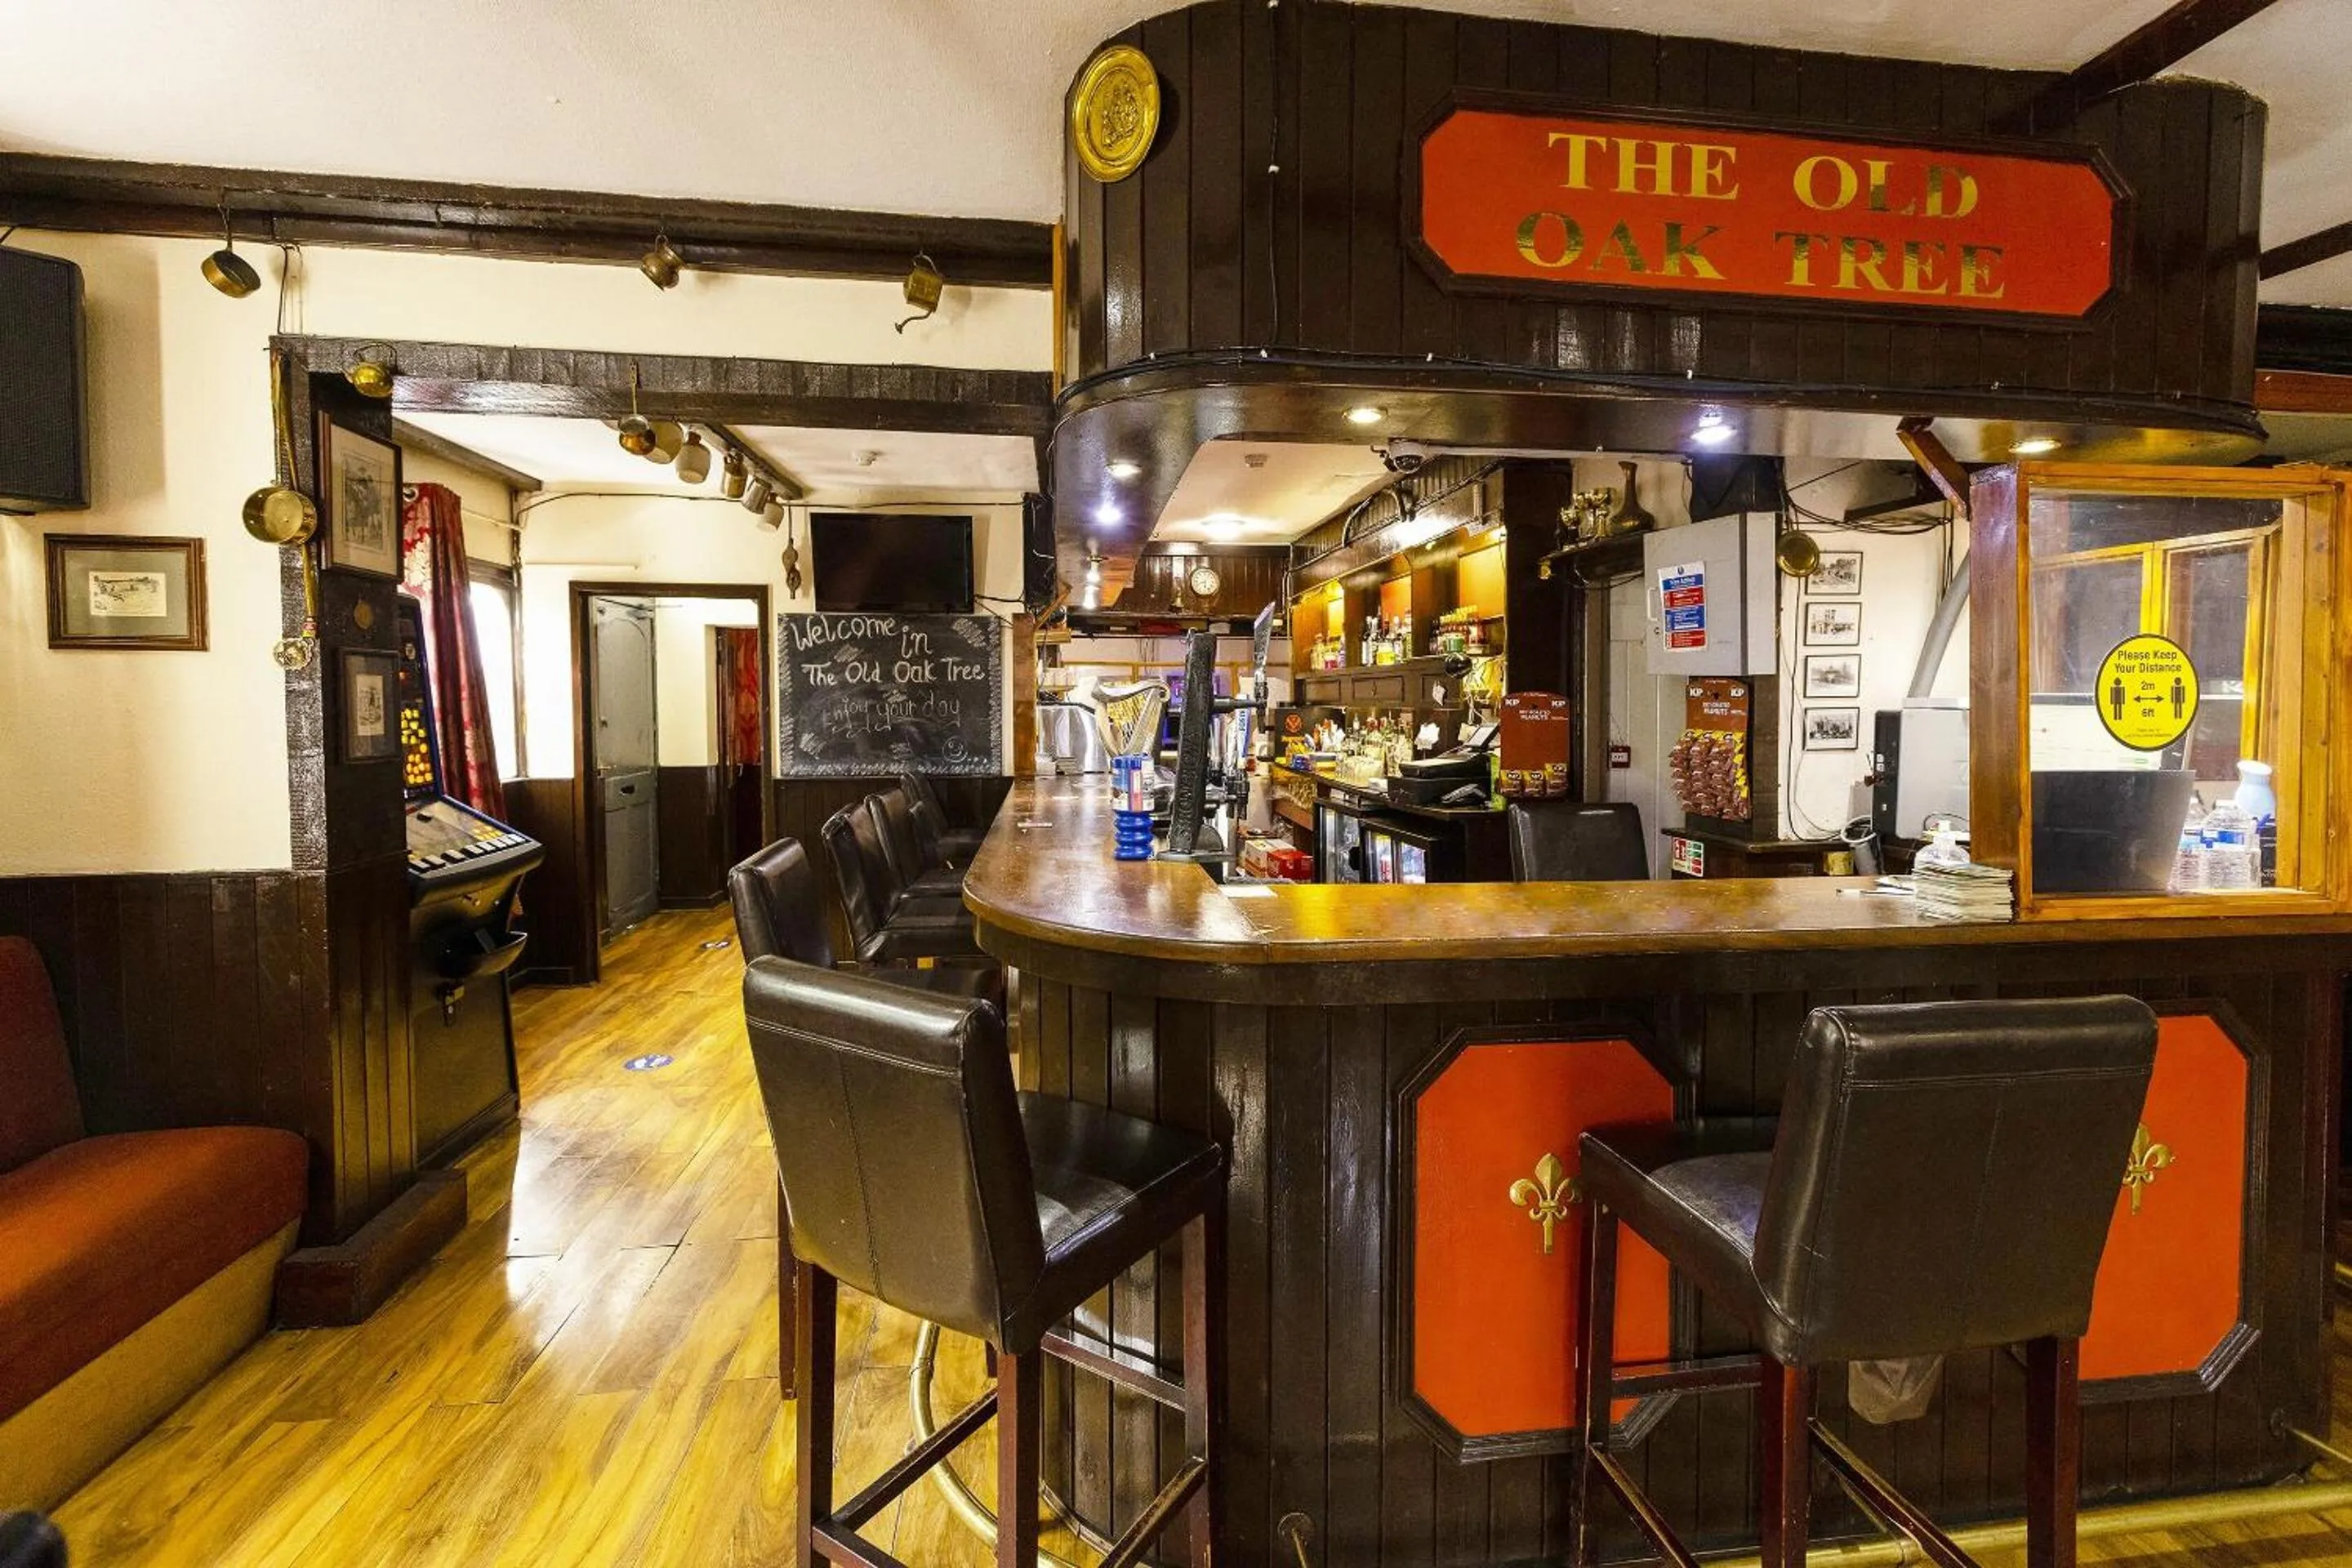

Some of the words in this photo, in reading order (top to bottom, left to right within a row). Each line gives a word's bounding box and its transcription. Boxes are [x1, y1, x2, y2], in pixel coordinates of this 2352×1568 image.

[1547, 132, 1738, 200] THE
[1793, 155, 1979, 219] OLD
[1516, 212, 1726, 280] OAK
[1774, 229, 2006, 300] TREE
[791, 614, 897, 651] Welcome
[901, 626, 934, 658] in
[2118, 650, 2151, 661] Please
[2154, 650, 2177, 661] Keep
[801, 662, 837, 686] The
[845, 662, 882, 684] Old
[894, 660, 938, 684] Oak
[940, 657, 986, 681] Tree
[2114, 663, 2136, 673] Your
[2139, 662, 2182, 673] Distance
[2140, 680, 2155, 691] 2m
[1689, 688, 1704, 697] KP
[1731, 688, 1744, 697] KP
[1504, 698, 1520, 706] KP
